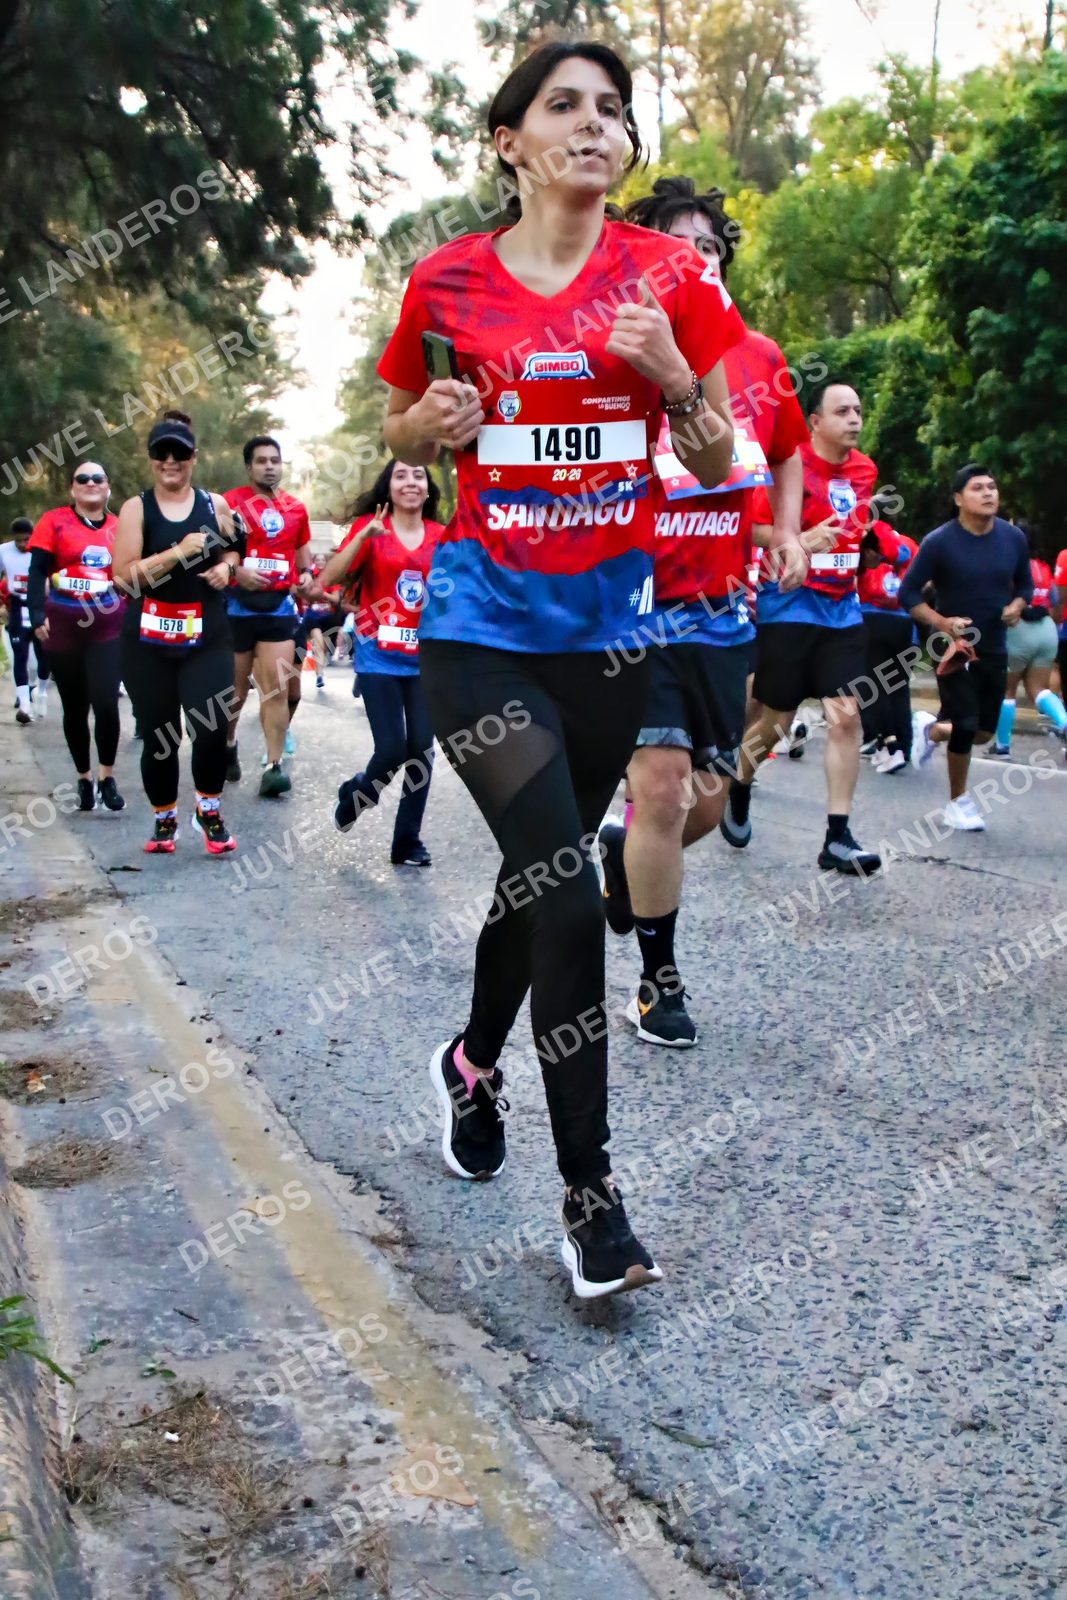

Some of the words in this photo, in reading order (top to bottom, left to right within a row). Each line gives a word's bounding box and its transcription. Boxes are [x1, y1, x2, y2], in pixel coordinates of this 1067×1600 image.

[534, 361, 579, 372] BIMBO
[582, 395, 630, 405] COMPARTIMOS
[531, 426, 601, 461] 1490
[618, 480, 633, 492] 5K
[487, 499, 636, 530] SANTIAGO
[654, 511, 740, 537] ANTIAGO
[833, 555, 852, 567] 3611
[69, 579, 91, 591] 1430
[159, 618, 183, 632] 1578
